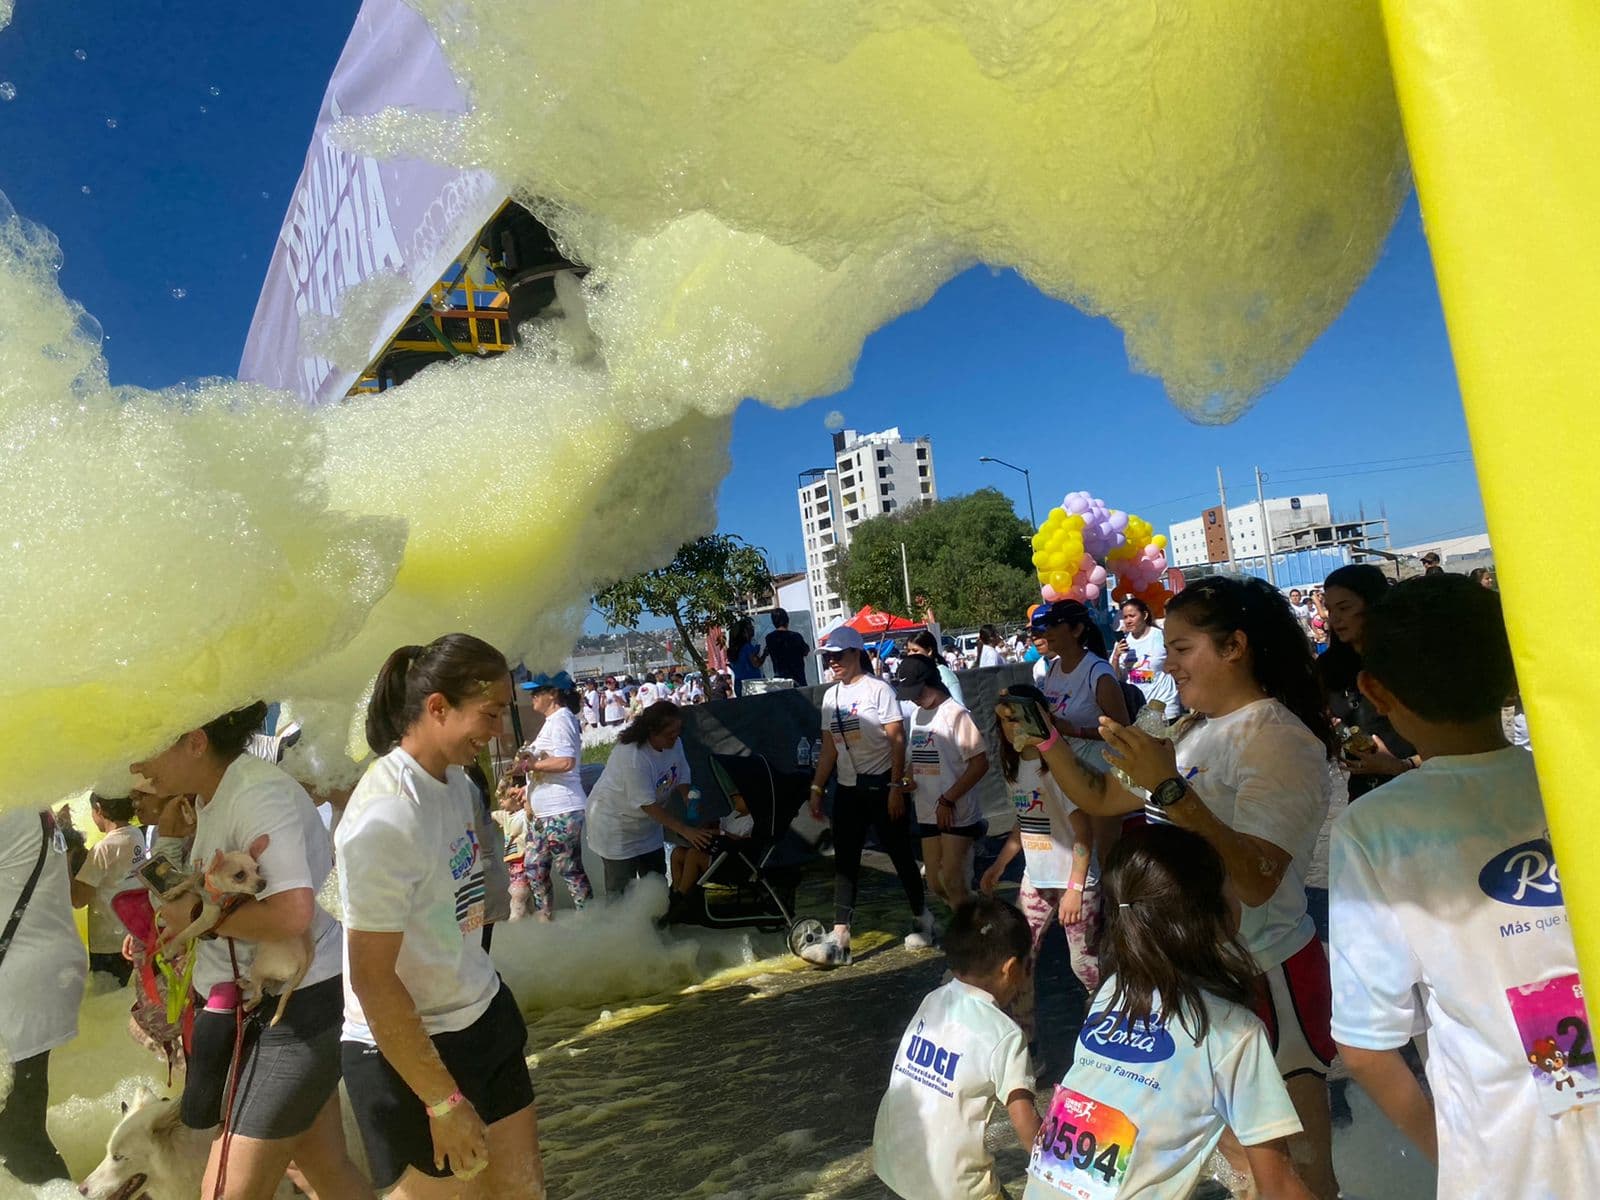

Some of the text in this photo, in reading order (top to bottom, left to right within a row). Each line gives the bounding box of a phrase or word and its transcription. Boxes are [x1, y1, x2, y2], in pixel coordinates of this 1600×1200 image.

[1499, 921, 1532, 938] Más
[1535, 914, 1561, 931] que
[1085, 1015, 1156, 1053] Roma
[906, 1034, 960, 1082] UDCI
[1079, 1056, 1096, 1067] que
[1042, 1116, 1121, 1184] 0594
